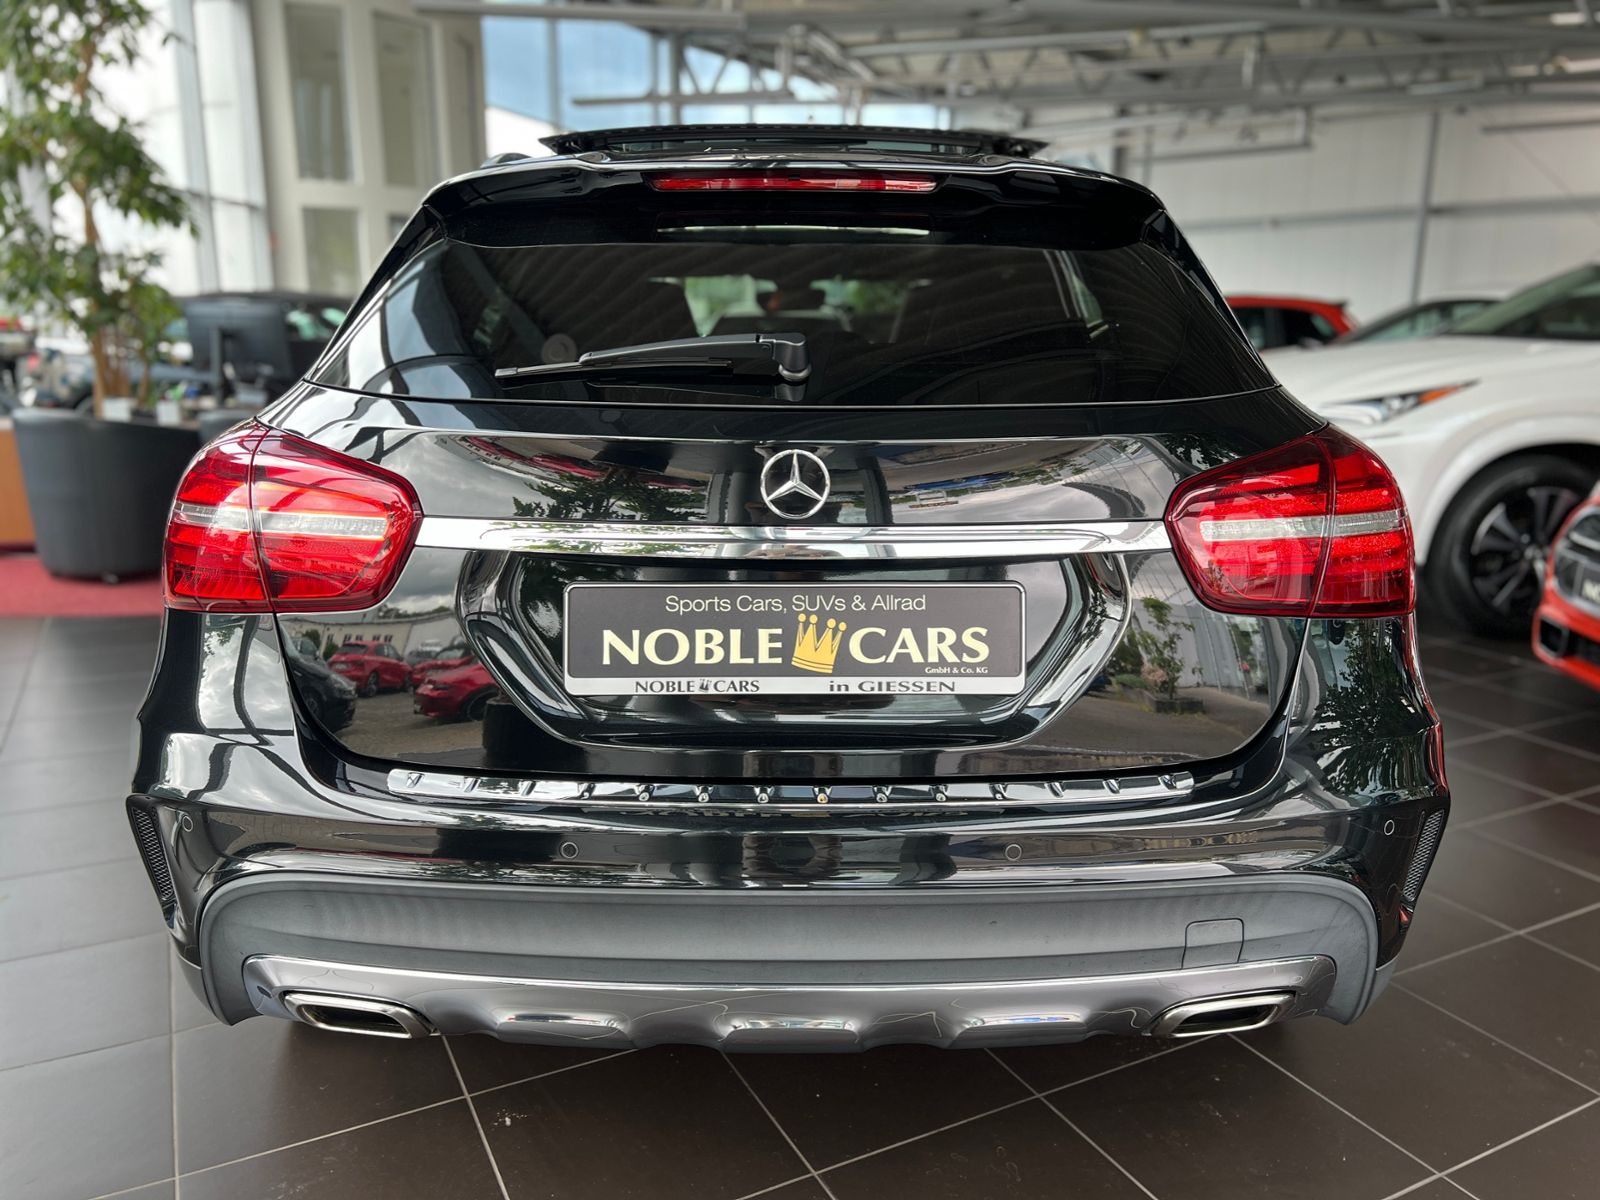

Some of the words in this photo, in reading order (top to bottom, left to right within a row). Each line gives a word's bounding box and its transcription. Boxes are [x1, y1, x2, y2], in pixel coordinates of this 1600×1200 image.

[665, 595, 731, 615] Sports
[736, 595, 787, 614] Cars,
[791, 595, 846, 611] SUVs
[851, 595, 867, 611] &
[871, 594, 926, 611] Allrad
[602, 628, 783, 665] NOBLE
[849, 626, 990, 664] CARS
[635, 680, 695, 693] NOBLE
[714, 680, 760, 693] CARS
[829, 680, 849, 692] in
[858, 681, 955, 693] GIESSEN
